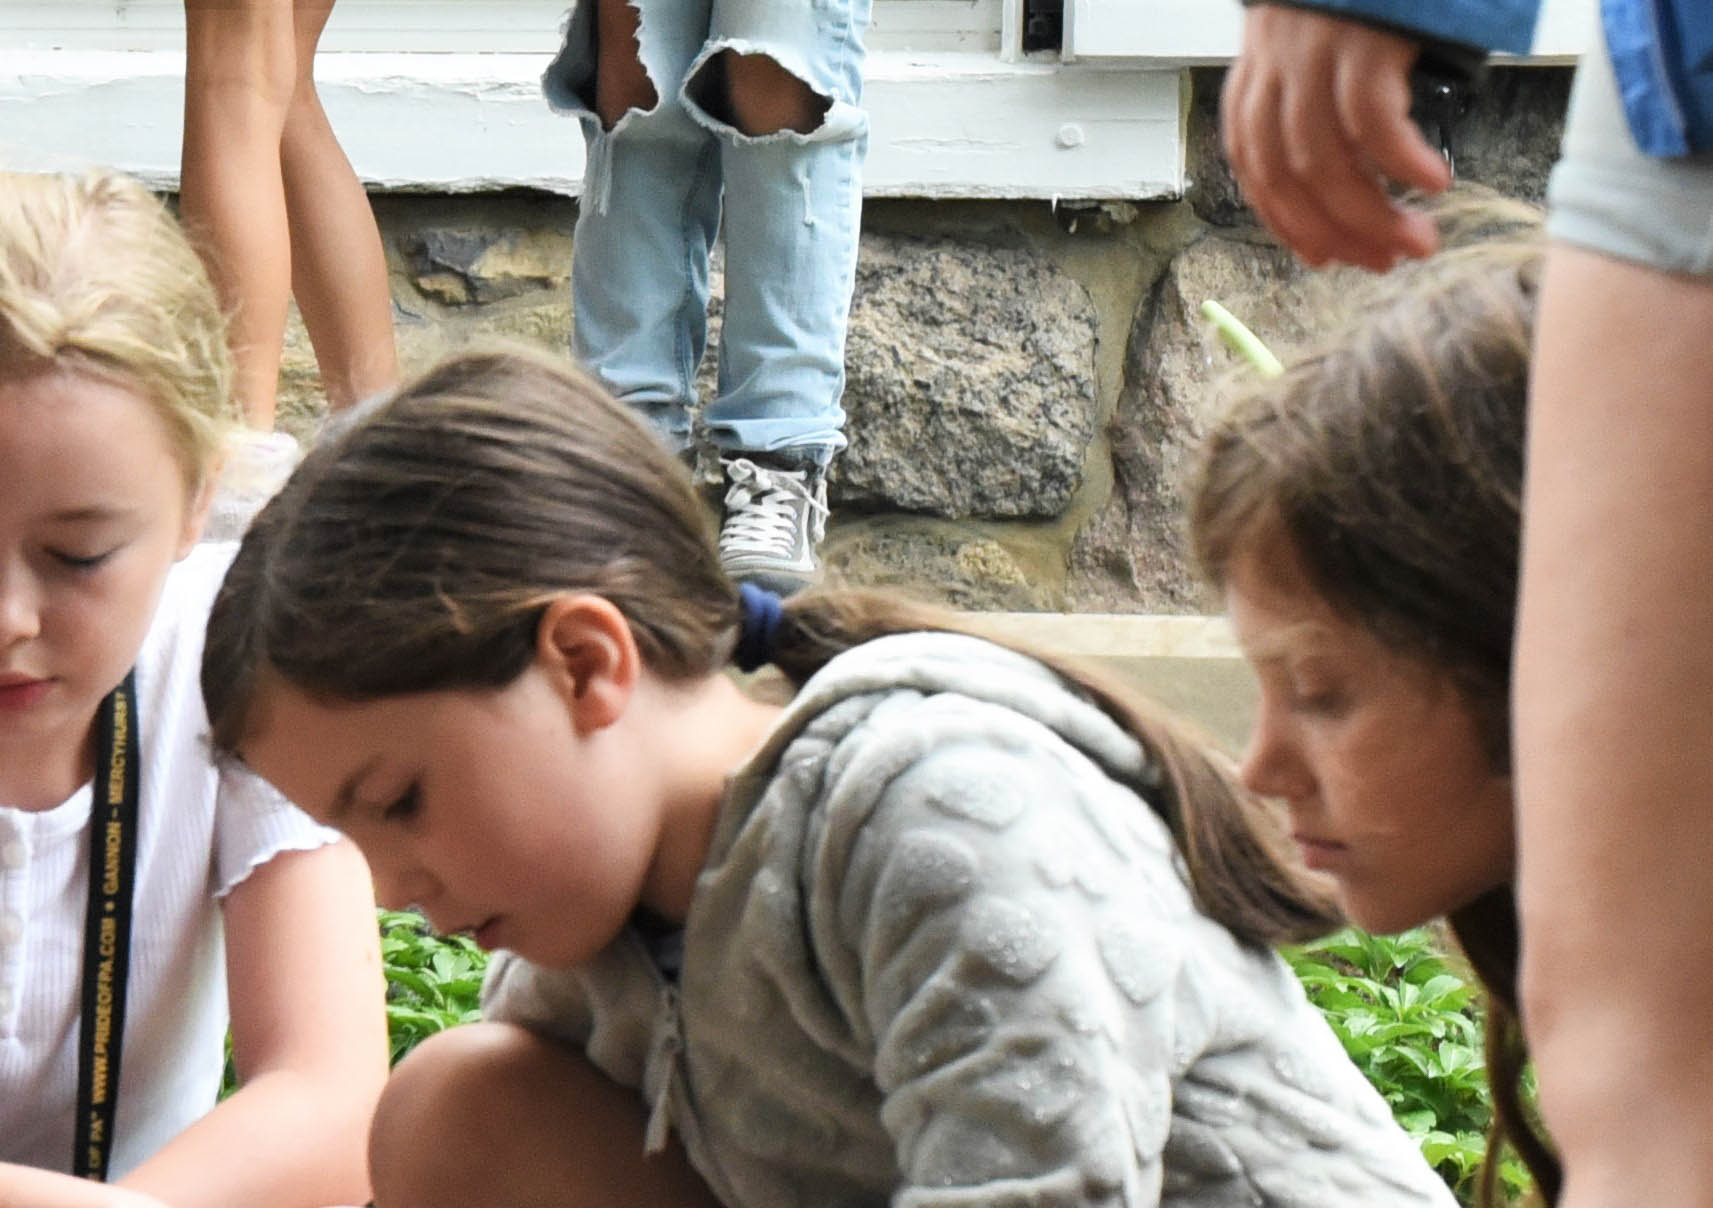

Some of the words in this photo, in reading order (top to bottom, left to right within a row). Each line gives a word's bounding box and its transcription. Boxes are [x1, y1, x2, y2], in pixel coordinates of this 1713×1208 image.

[107, 692, 127, 805] MERCYHURST
[102, 821, 122, 895] GANNON
[91, 917, 116, 1105] WWW.PRIDEOFPA.COM
